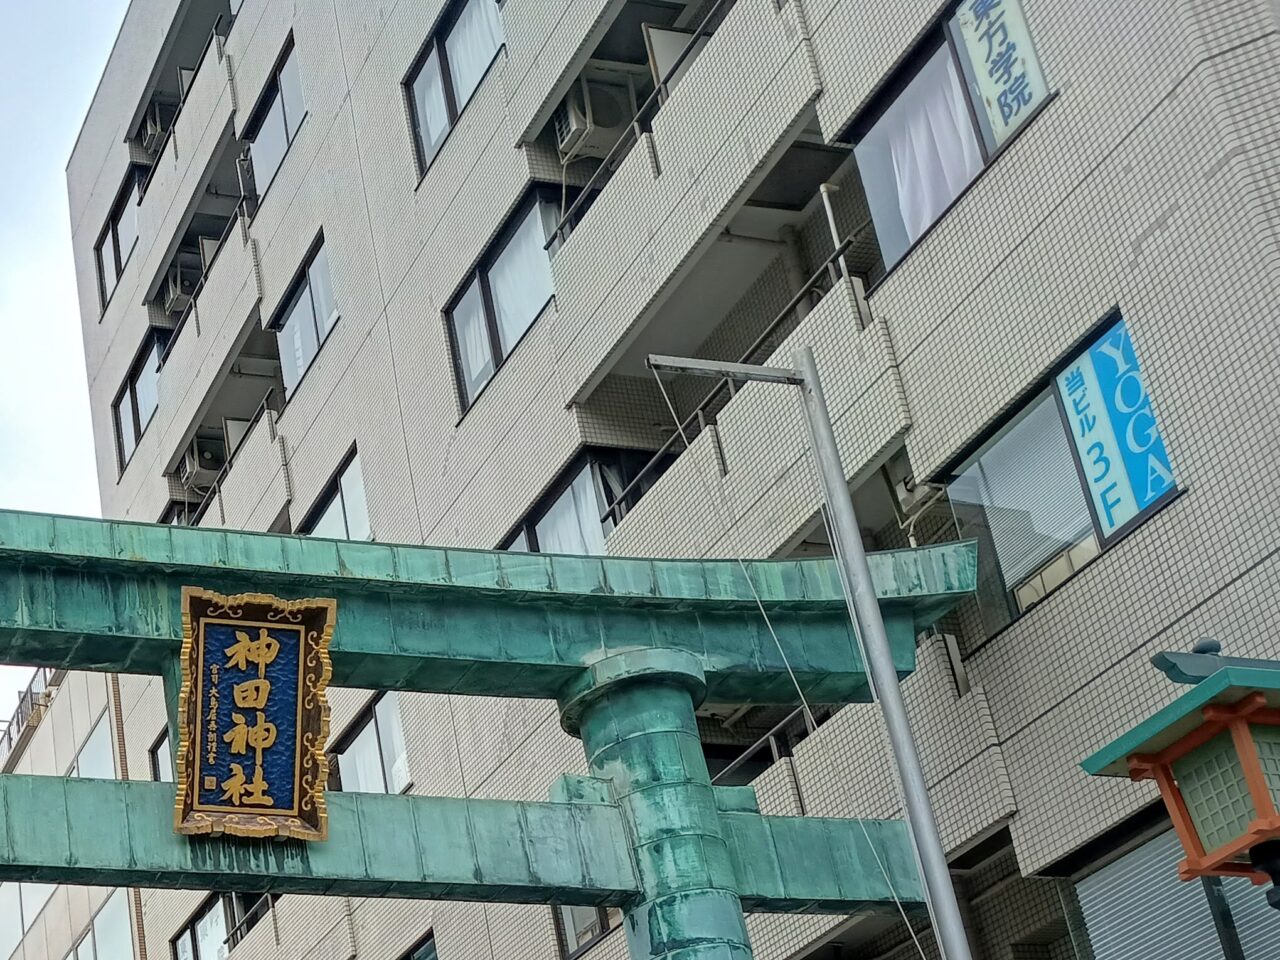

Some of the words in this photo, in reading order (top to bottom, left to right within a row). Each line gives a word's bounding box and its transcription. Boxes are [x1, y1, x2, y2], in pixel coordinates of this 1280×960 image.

[1063, 366, 1097, 439] 当ビル
[1086, 442, 1122, 528] 3F
[1095, 328, 1174, 501] YOGA
[221, 628, 281, 806] 神田神社
